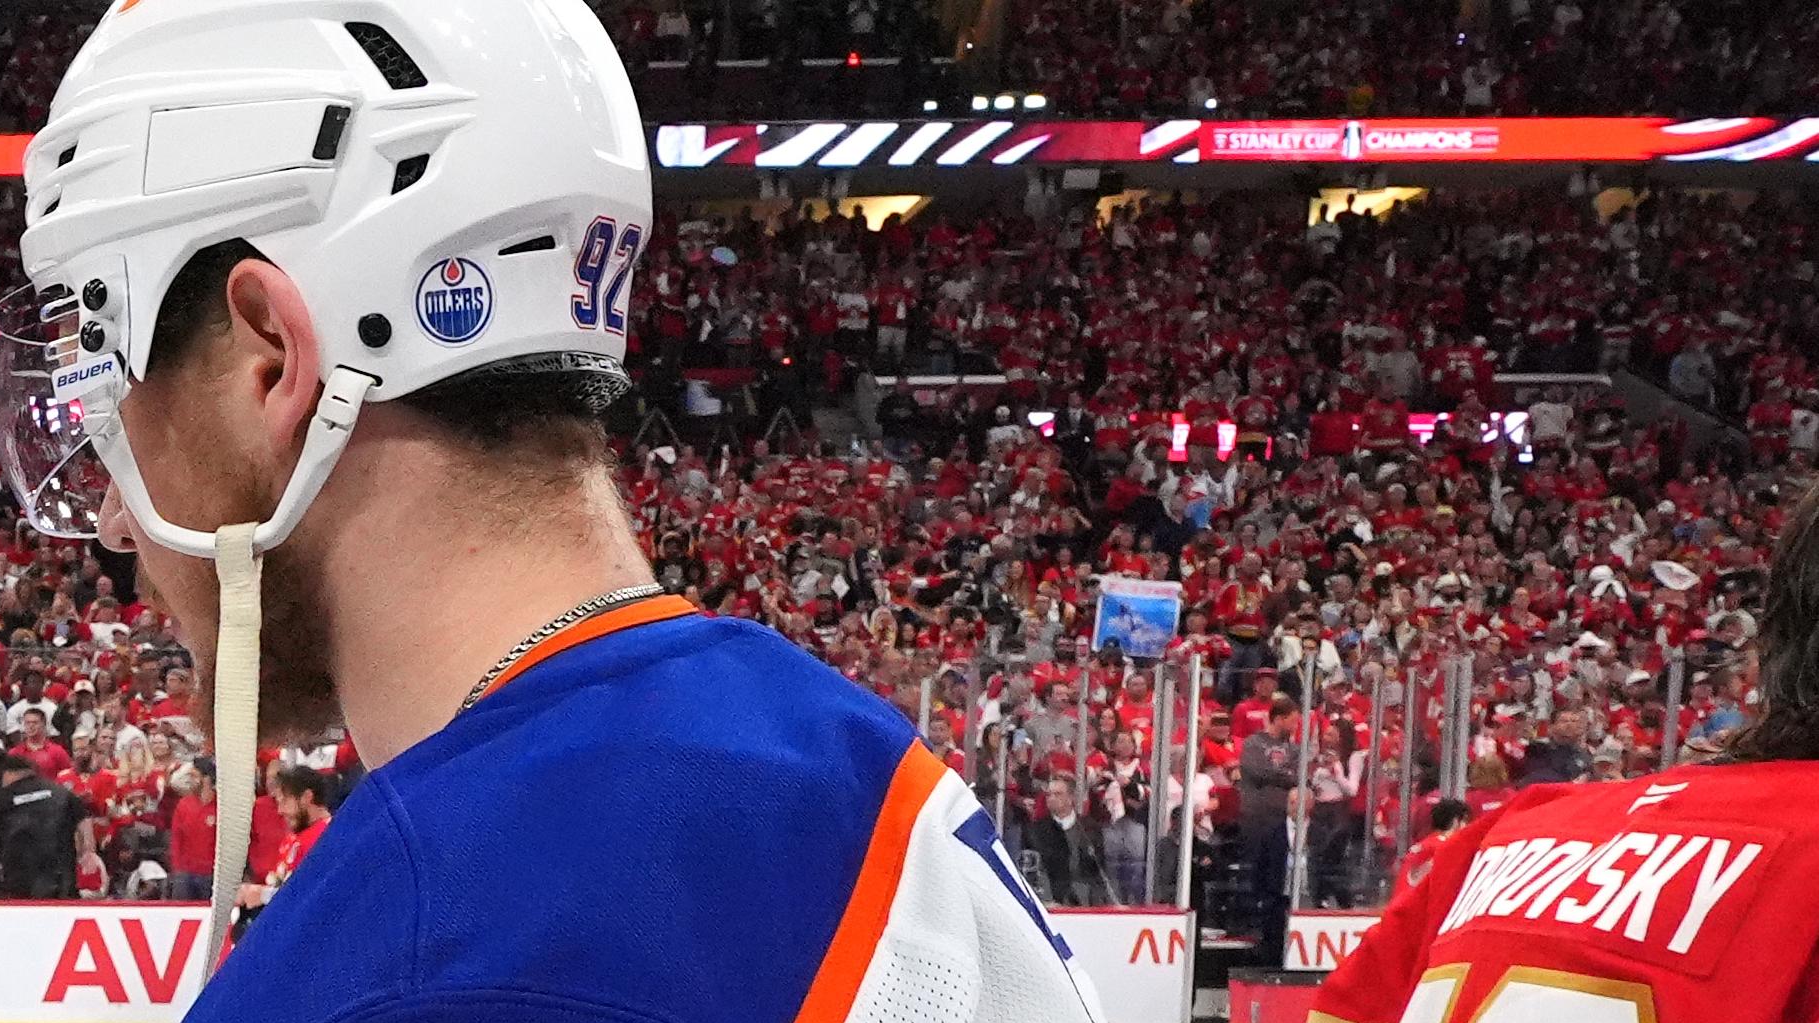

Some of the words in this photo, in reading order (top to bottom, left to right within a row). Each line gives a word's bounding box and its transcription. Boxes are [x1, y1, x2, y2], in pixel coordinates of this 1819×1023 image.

[1230, 133, 1302, 150] STANLEY
[1304, 132, 1339, 149] CUP
[1365, 131, 1473, 149] CHAMPIONS
[570, 215, 642, 337] 92
[424, 286, 484, 314] OILERS
[56, 360, 113, 388] BAUER
